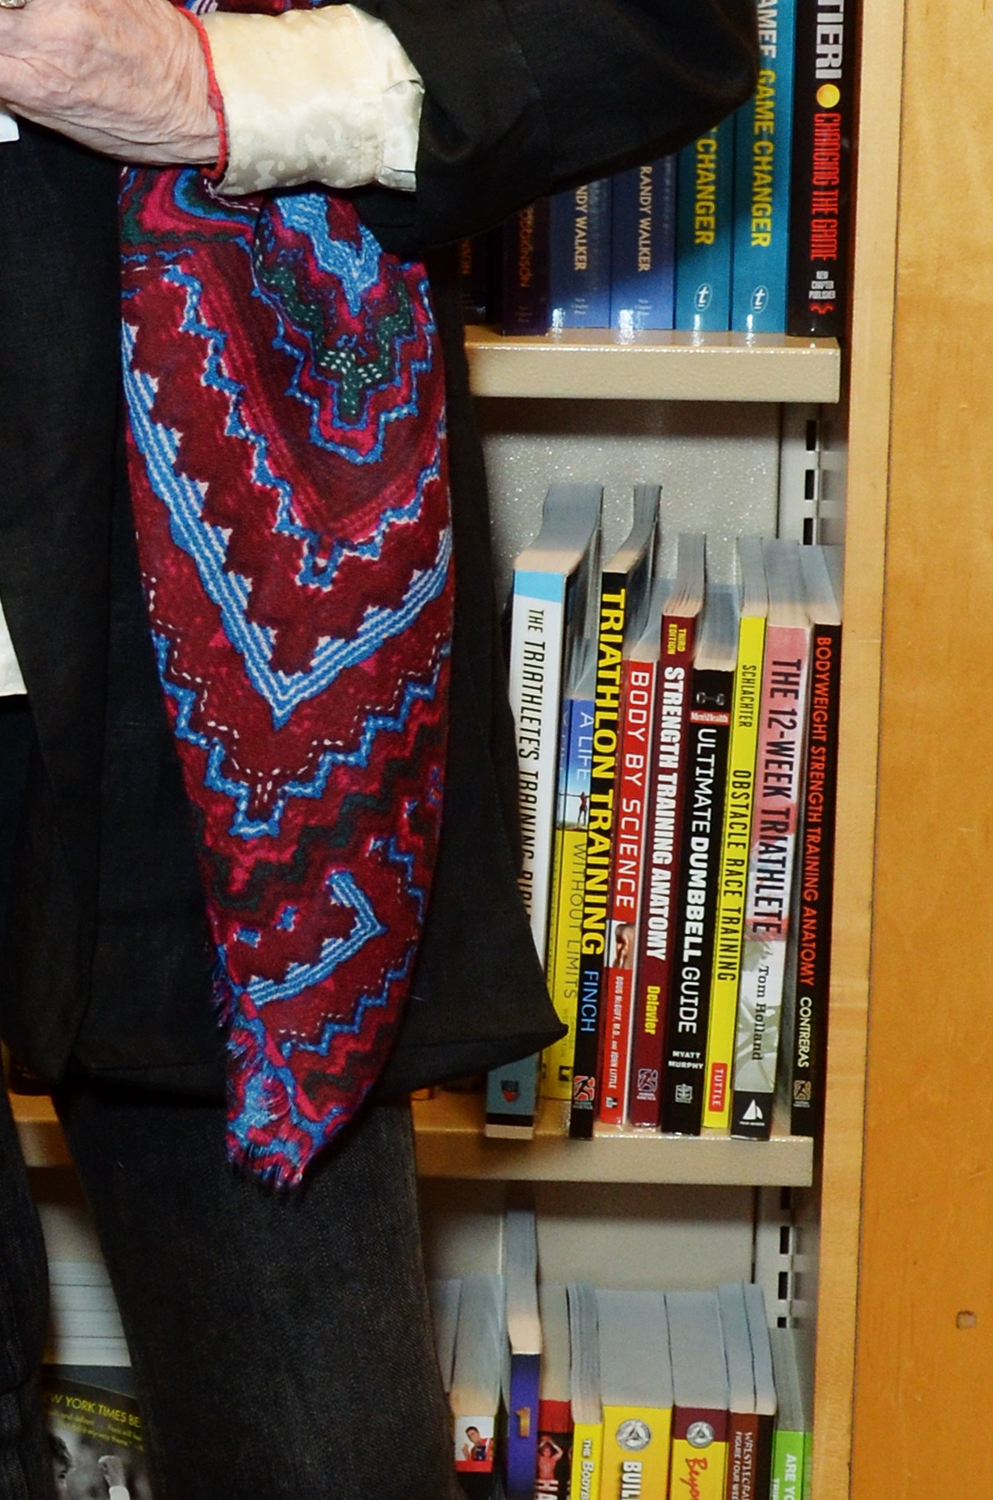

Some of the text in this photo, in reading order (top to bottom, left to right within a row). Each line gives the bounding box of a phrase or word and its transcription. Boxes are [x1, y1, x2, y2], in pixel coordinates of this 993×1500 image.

[755, 69, 776, 135] GAME
[811, 112, 842, 187] CHANGING
[637, 166, 654, 273] RANDY WALKER
[751, 141, 775, 247] CHANGER
[809, 218, 838, 262] GAME
[811, 188, 840, 216] THE
[526, 608, 546, 634] THE
[518, 641, 546, 761] TRIATHLETE'S
[580, 711, 595, 729] A
[576, 735, 593, 781] LIFE
[580, 588, 626, 1032] TRIATHLON TRAINING FINCH
[616, 670, 651, 909] BODY BY SCIENCE
[644, 667, 685, 1035] STRENGTH TRAINING ANATOMY Delavier
[717, 665, 757, 982] SCHLACHTER OBSTACLE RACE TRAINING
[751, 659, 802, 1061] THE 12-WEEK TRIATHLETE Tom Holland
[797, 636, 832, 1068] BODYWEIGHT STRENGTH TRAINING ANATOMY CONTRERAS
[568, 842, 587, 934] WITHOUT
[678, 728, 717, 1034] ULTIMATE DUMBBELL GUIDE
[563, 938, 582, 999] LIMITS
